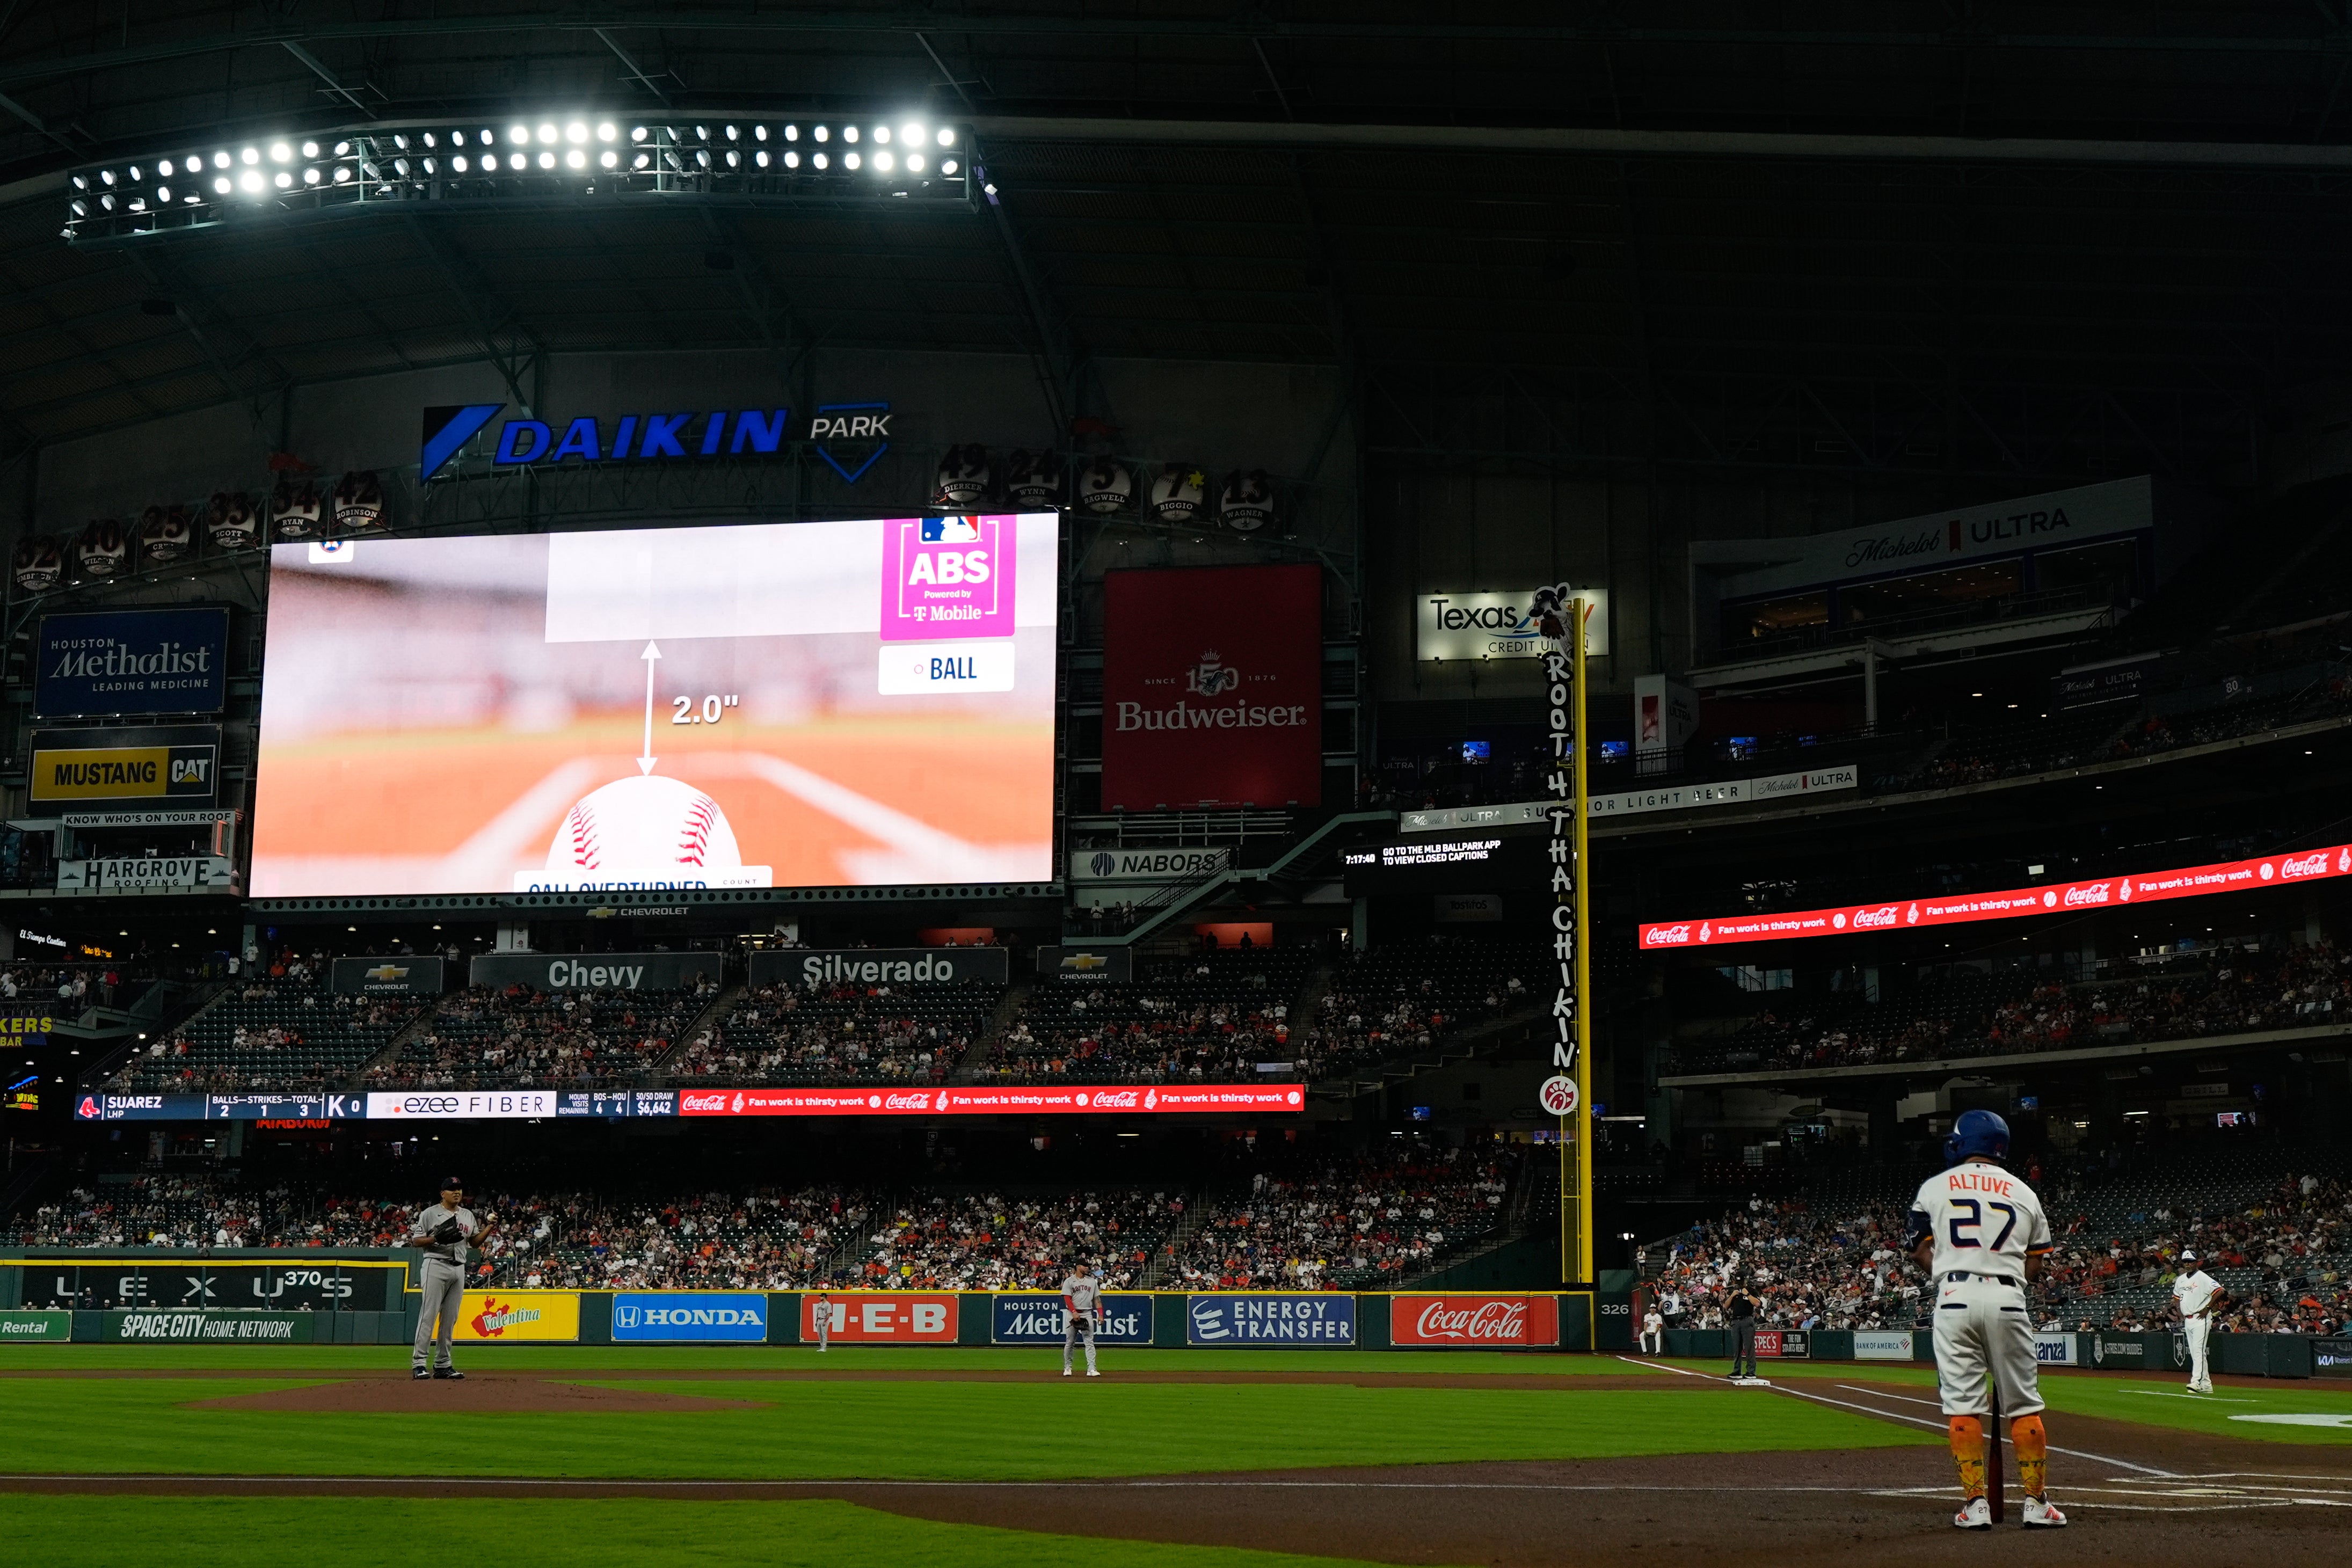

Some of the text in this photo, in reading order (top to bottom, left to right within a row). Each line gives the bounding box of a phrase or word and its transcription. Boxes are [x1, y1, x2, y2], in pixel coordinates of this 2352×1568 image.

[493, 407, 892, 466] DAIKIN PARK
[940, 442, 986, 478] 49
[1009, 448, 1054, 483] 24
[1091, 455, 1115, 487] 5
[1166, 463, 1190, 497] 7
[272, 479, 317, 514] 34
[334, 470, 378, 505] 42
[944, 483, 982, 493] DIERKER
[208, 492, 249, 525] 33
[1084, 494, 1125, 506] BAGWELL
[1160, 502, 1193, 511] BIGGIO
[141, 505, 186, 538] 25
[282, 518, 304, 526] RYAN
[336, 509, 378, 520] ROBINSON
[1226, 509, 1263, 519] WAGNER
[78, 519, 122, 553] 40
[216, 530, 242, 538] SCOTT
[1846, 508, 2070, 568] Michelob ULTRA
[908, 550, 989, 585] ABS
[924, 589, 971, 599] Powered by
[930, 604, 981, 621] Mobile
[1430, 599, 1518, 630] Texas
[52, 638, 114, 650] HOUSTON
[1488, 641, 1534, 653] CREDIT
[48, 642, 210, 678] Methodist
[930, 657, 977, 680] BALL
[92, 679, 209, 691] LEADING MEDICINE
[1185, 662, 1240, 697] 150
[2106, 670, 2142, 685] ULTRA
[2225, 679, 2239, 694] 80
[672, 695, 739, 725] 2.0"
[1116, 699, 1305, 731] Budweiser
[1546, 655, 1571, 757] ROOT
[1669, 705, 1692, 723] ULTRA
[55, 759, 208, 785] MUSTANG CAT
[1383, 761, 1415, 769] ULTRA
[1548, 770, 1567, 797] 4
[1758, 772, 1853, 794] Michelob ULTRA
[1628, 786, 1738, 808] LIGHT BEER
[66, 812, 231, 824] KNOW WHO'S ON YOUR ROOF
[1461, 811, 1501, 822] ULTRA
[1383, 840, 1501, 856] GO TO THE MLB BALLPARK APP
[1383, 850, 1488, 865] TO VIEW CLOSED CAPTIONS
[1548, 811, 1572, 891] THA
[1122, 853, 1216, 873] NABORS
[1346, 854, 1375, 864] 7:17:40
[2282, 852, 2330, 879] Coca-Cola
[84, 860, 210, 887] HARGROVE
[2064, 883, 2111, 906] Coca-Cola
[621, 907, 689, 916] CHEVROLET
[1853, 906, 1899, 927] Coca-Cola
[20, 929, 26, 938] El
[1646, 925, 1692, 945] Coca-Cola
[1718, 918, 1826, 935] Fan work is thirsty work
[549, 960, 644, 989] Chevy
[803, 953, 953, 982] Silverado
[1551, 905, 1575, 1069] CHIKIN
[107, 1096, 162, 1109] SUAREZ
[328, 1095, 360, 1117] K 0
[404, 1097, 543, 1113] ezee FIBER
[636, 1092, 674, 1100] 50/50 DRAW
[682, 1095, 727, 1111] Coca-Cola
[885, 1093, 931, 1110] Coca-Cola
[1093, 1091, 1140, 1108] Coca-Cola
[1162, 1093, 1283, 1104] Fan work is thirsty work
[107, 1110, 124, 1119] LHP
[220, 1104, 308, 1117] 2 1 3
[596, 1102, 622, 1114] 4 4
[637, 1100, 671, 1116] $6,642
[1949, 1174, 2013, 1198] ALTUVE
[1949, 1199, 2017, 1252] 27
[56, 1276, 353, 1298] LEXUS
[284, 1271, 322, 1286] 370
[1004, 1302, 1058, 1310] HOUSTON
[1234, 1300, 1327, 1320] ENERGY
[1601, 1304, 1629, 1315] 326
[2, 1321, 48, 1333] Rental
[120, 1315, 294, 1338] SPACE CITY HOME NETWORK
[483, 1307, 540, 1332] Valentina
[644, 1309, 764, 1325] HONDA
[812, 1303, 946, 1333] H-E-B
[1417, 1301, 1529, 1339] Coca-Cola
[1235, 1319, 1350, 1339] TRANSFER
